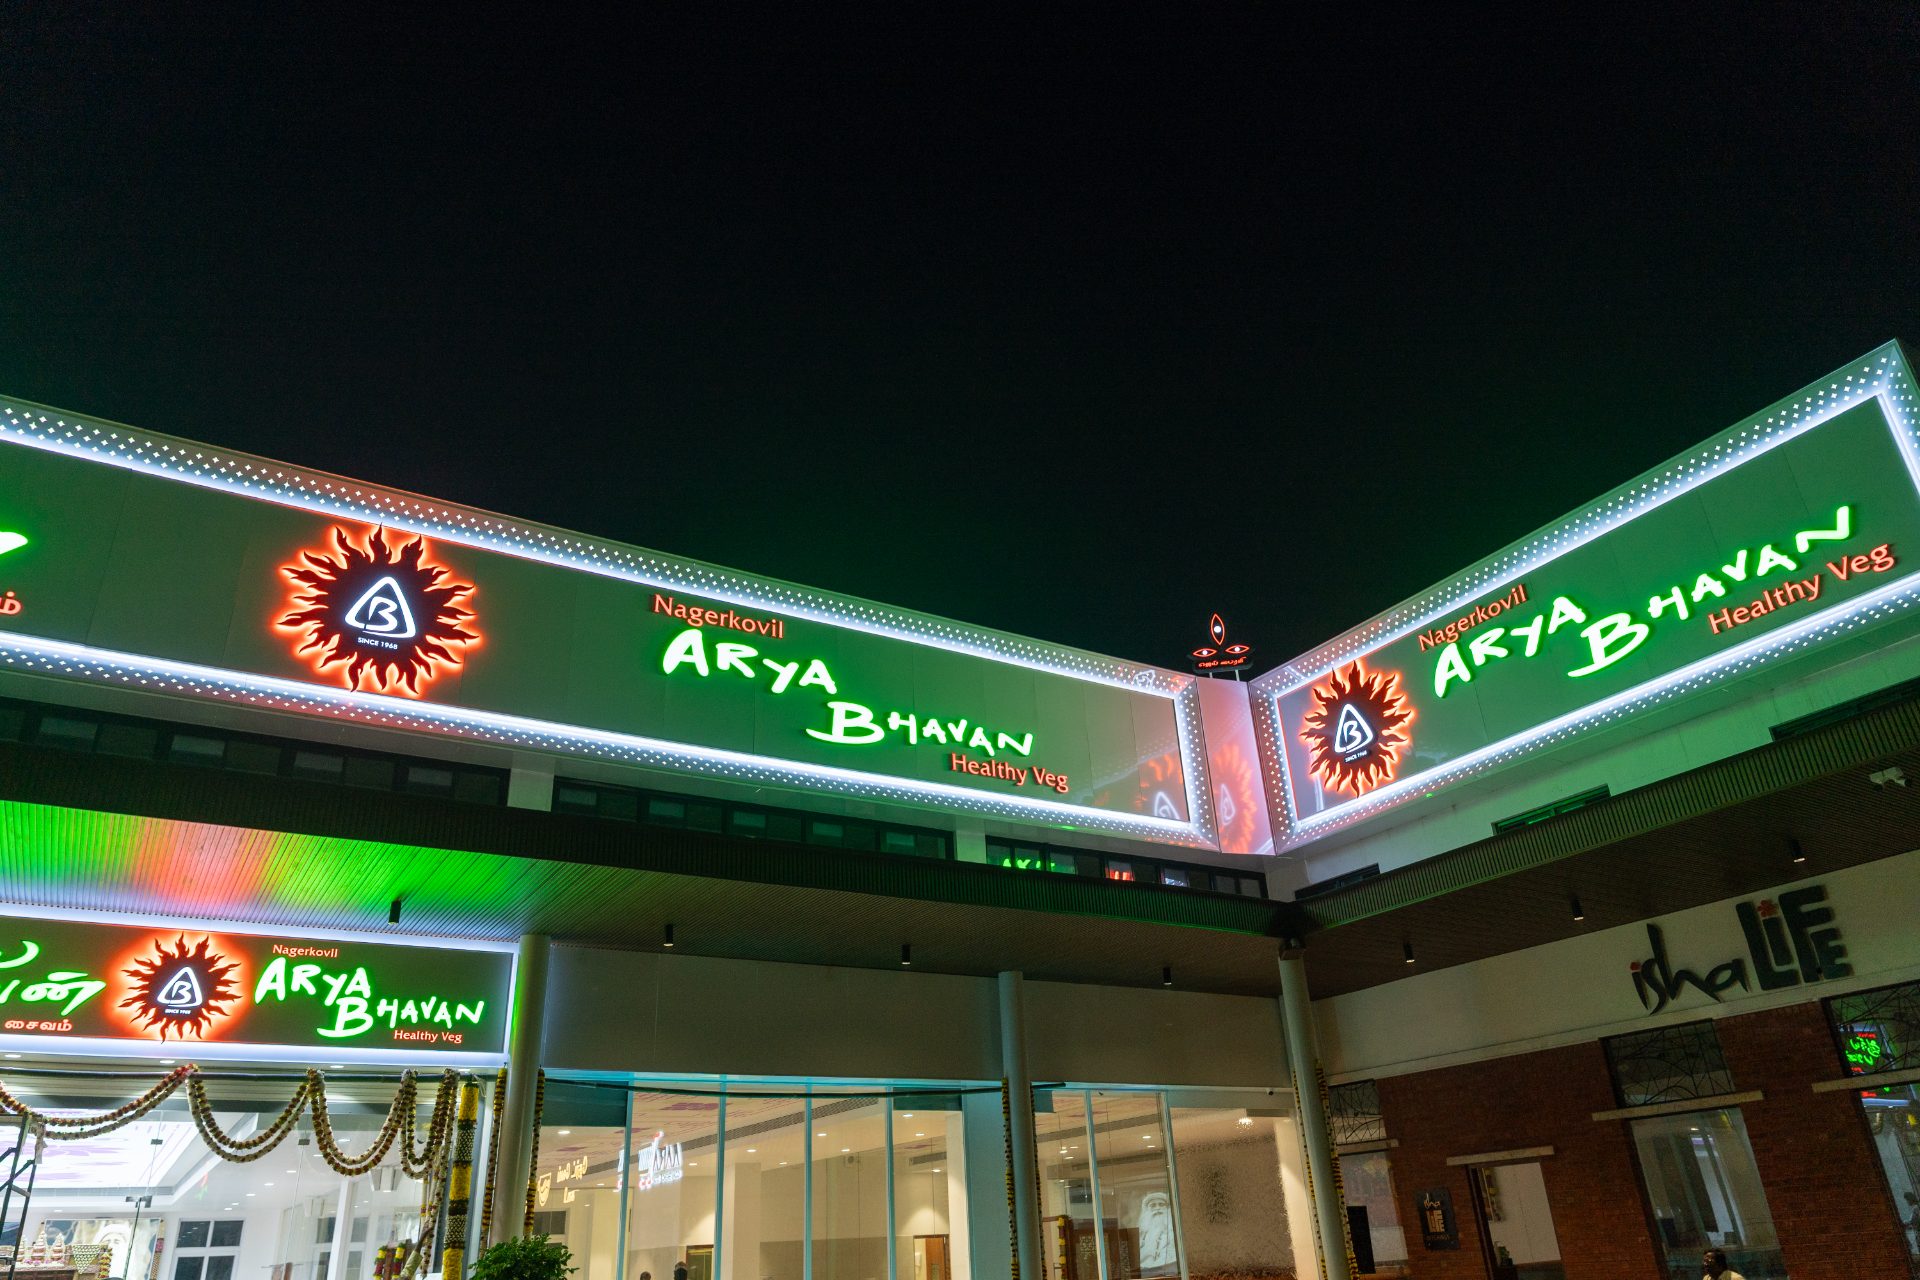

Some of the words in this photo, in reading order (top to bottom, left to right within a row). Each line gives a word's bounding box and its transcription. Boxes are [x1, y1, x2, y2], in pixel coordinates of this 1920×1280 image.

[652, 593, 786, 639] Nagerkovil
[1567, 505, 1851, 679] BHAVAN
[1708, 574, 1822, 636] Healthy
[1826, 543, 1896, 582] Veg
[357, 637, 379, 647] SINCE
[381, 641, 398, 650] 1968
[1417, 583, 1529, 652] Nagerkovil
[662, 628, 837, 695] ARYA
[1434, 596, 1588, 699] ARYA
[805, 701, 1034, 757] BHAVAN
[950, 752, 1028, 787] Healthy
[1032, 766, 1070, 794] Veg
[272, 944, 339, 958] Nagerkovil
[1630, 923, 1752, 1016] isha
[254, 957, 372, 1007] ARYA
[316, 996, 485, 1038] BHAVAN
[393, 1029, 438, 1043] Healthy
[441, 1031, 463, 1044] Veg
